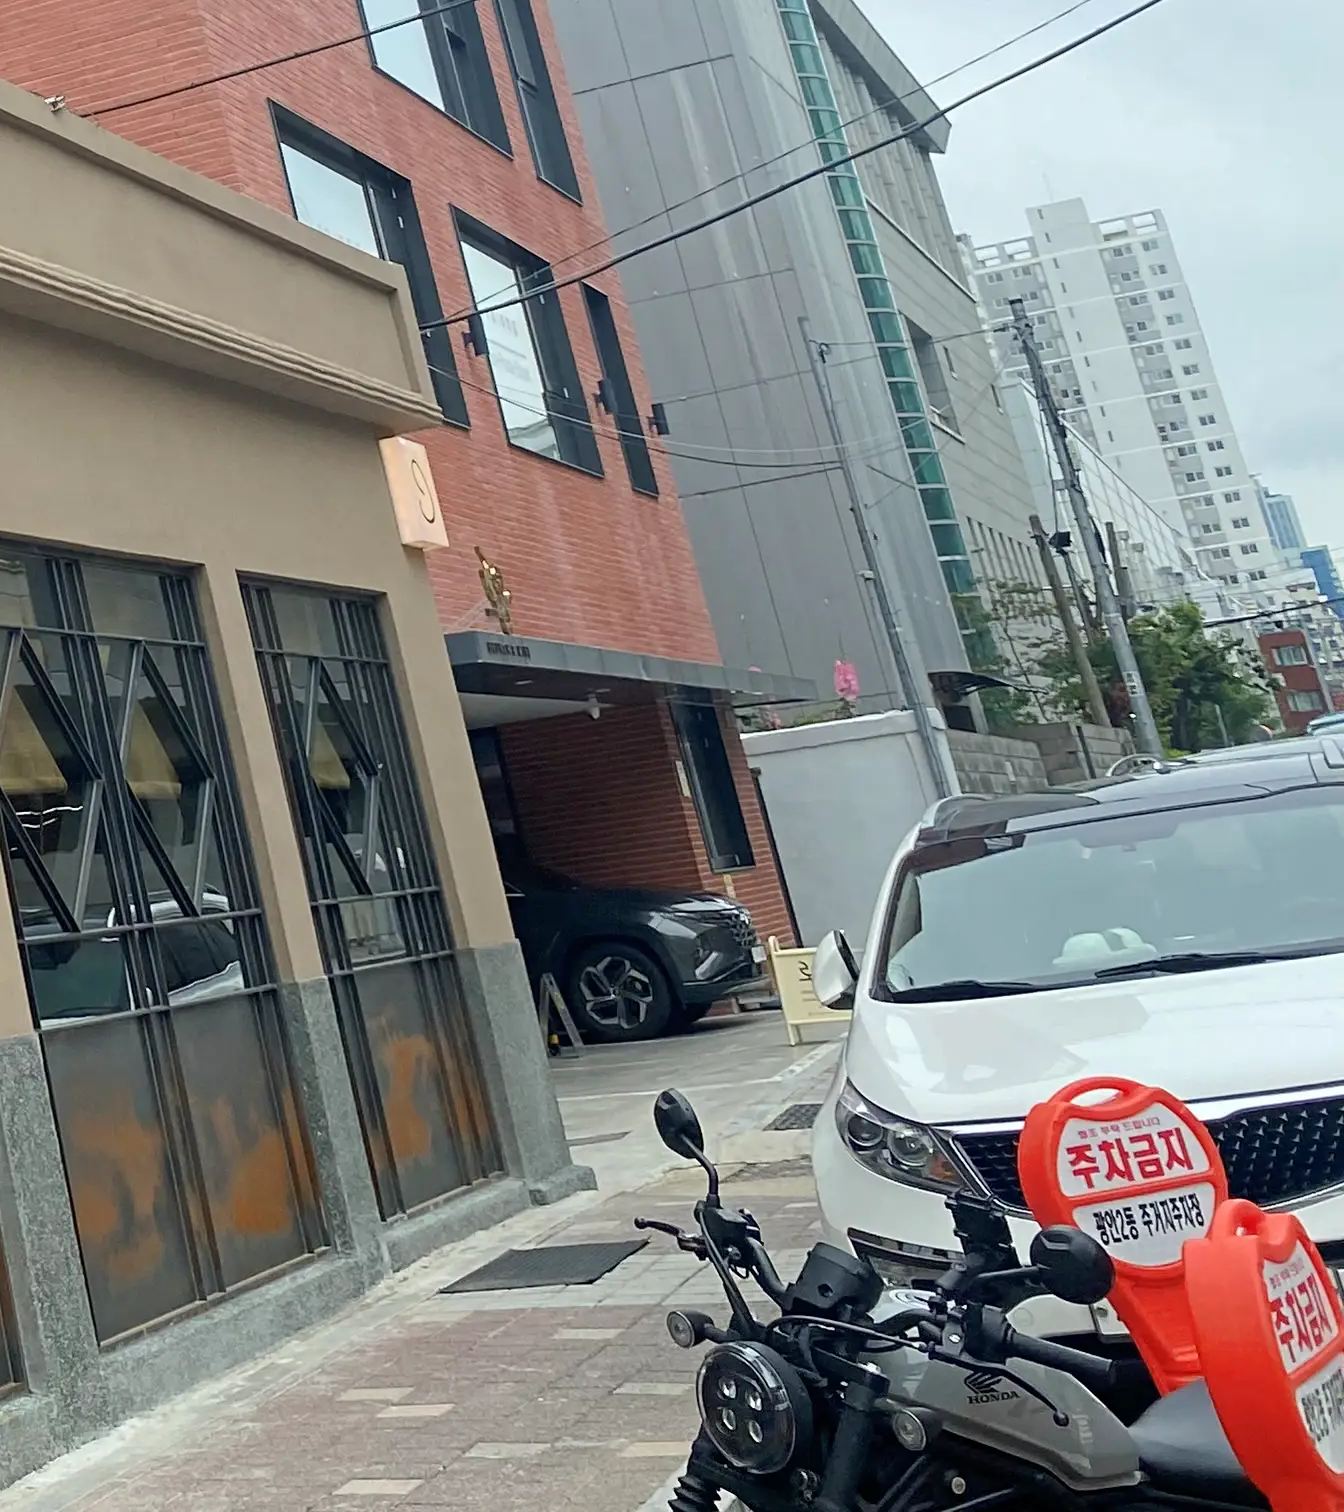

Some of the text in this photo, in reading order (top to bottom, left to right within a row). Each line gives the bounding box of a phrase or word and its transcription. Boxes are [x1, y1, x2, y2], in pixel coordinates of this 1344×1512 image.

[1066, 1127, 1194, 1189] 주차금지
[1092, 1193, 1205, 1246] 광안2동 주거지주차장
[967, 1391, 1021, 1404] HONDA
